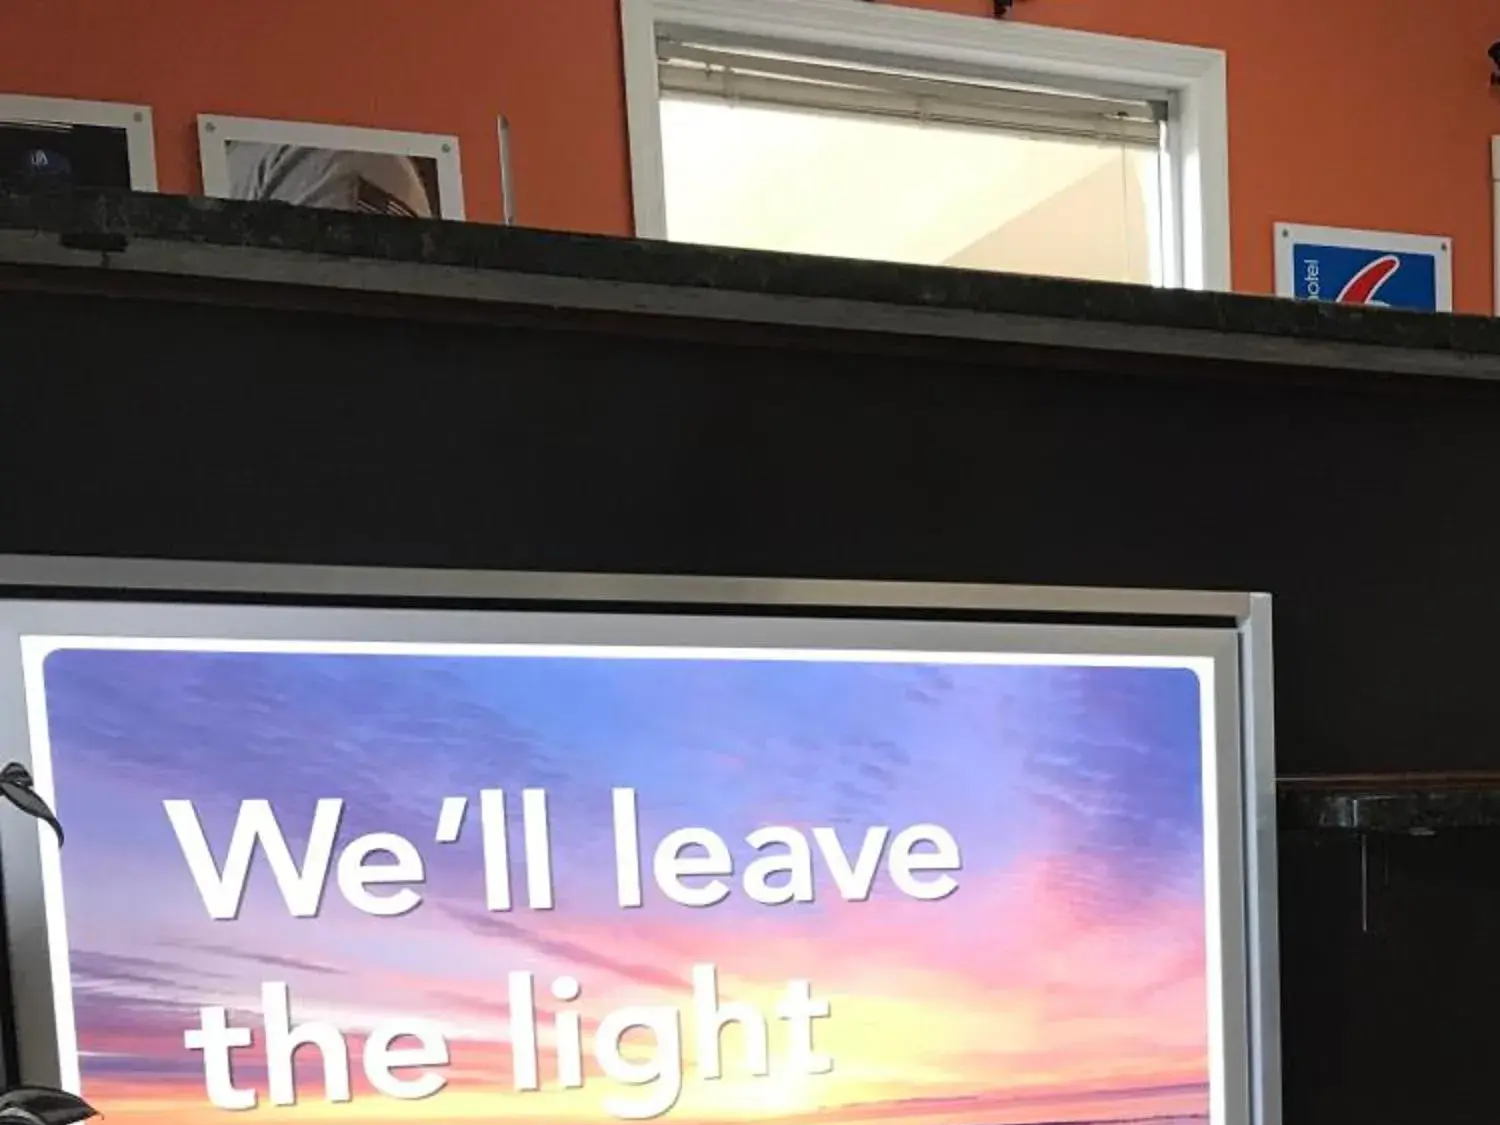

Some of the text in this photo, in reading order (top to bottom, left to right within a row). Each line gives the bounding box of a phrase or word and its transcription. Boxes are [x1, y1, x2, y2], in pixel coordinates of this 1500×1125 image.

[1304, 259, 1319, 300] otel
[165, 788, 962, 920] We'll leave
[185, 964, 834, 1118] the light
